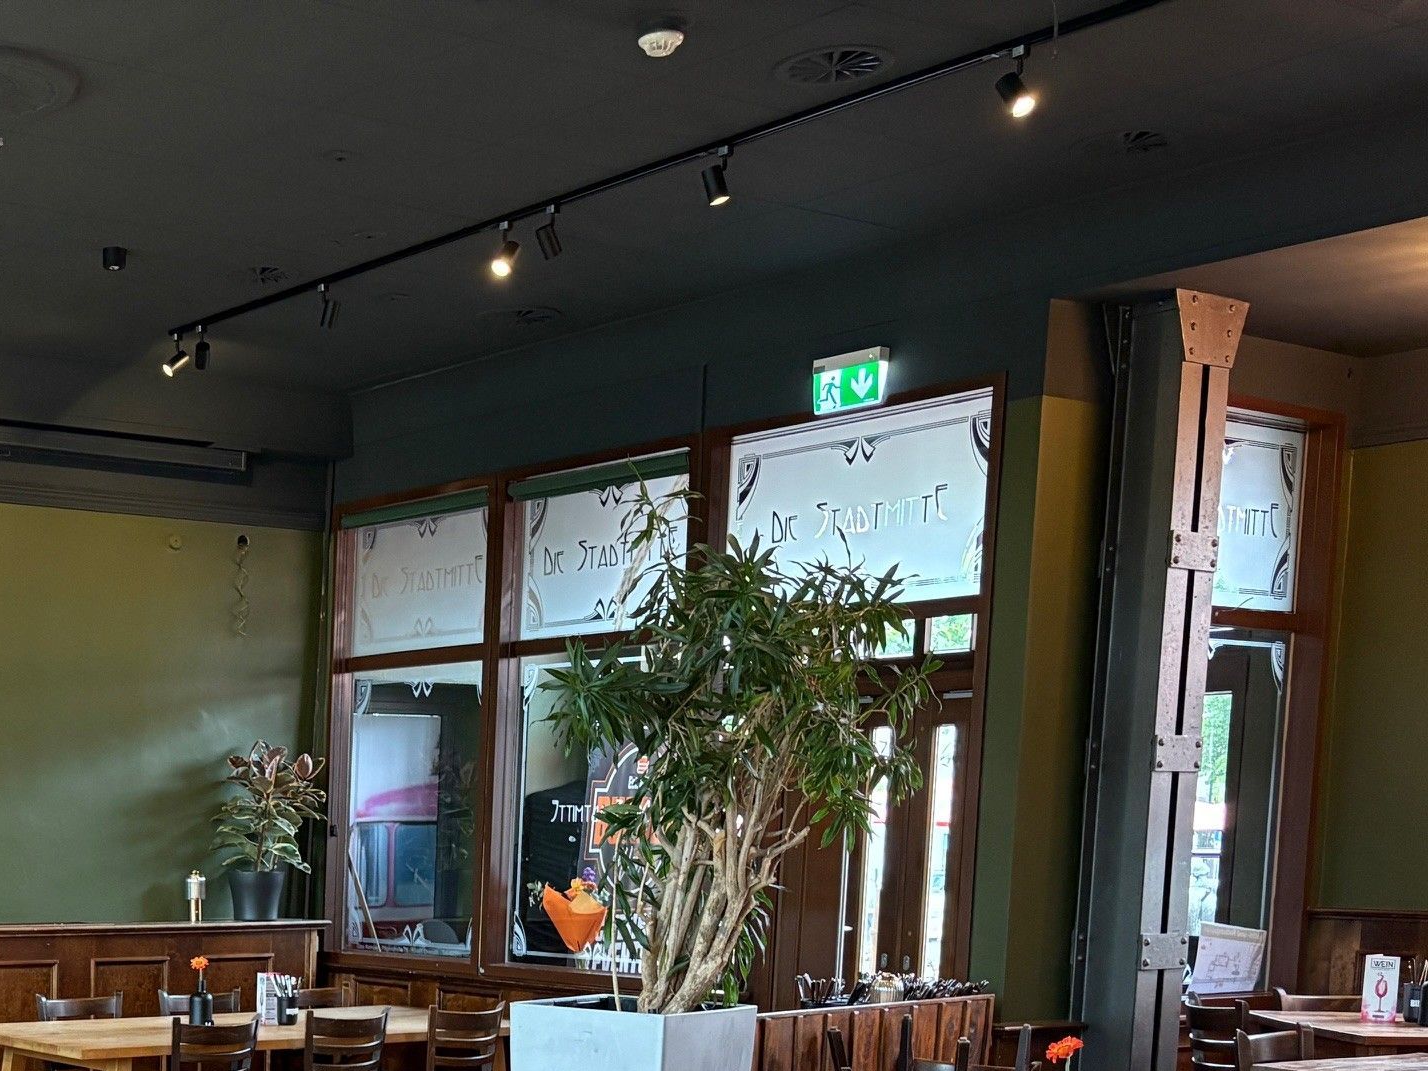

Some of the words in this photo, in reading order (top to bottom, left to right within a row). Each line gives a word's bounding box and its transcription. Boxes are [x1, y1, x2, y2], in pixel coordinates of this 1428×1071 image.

[772, 511, 798, 543] DIE
[815, 483, 948, 538] STADTMITTE
[401, 554, 483, 594] STADTMITTE
[543, 546, 564, 576] DIE
[1373, 960, 1394, 968] WEIN
